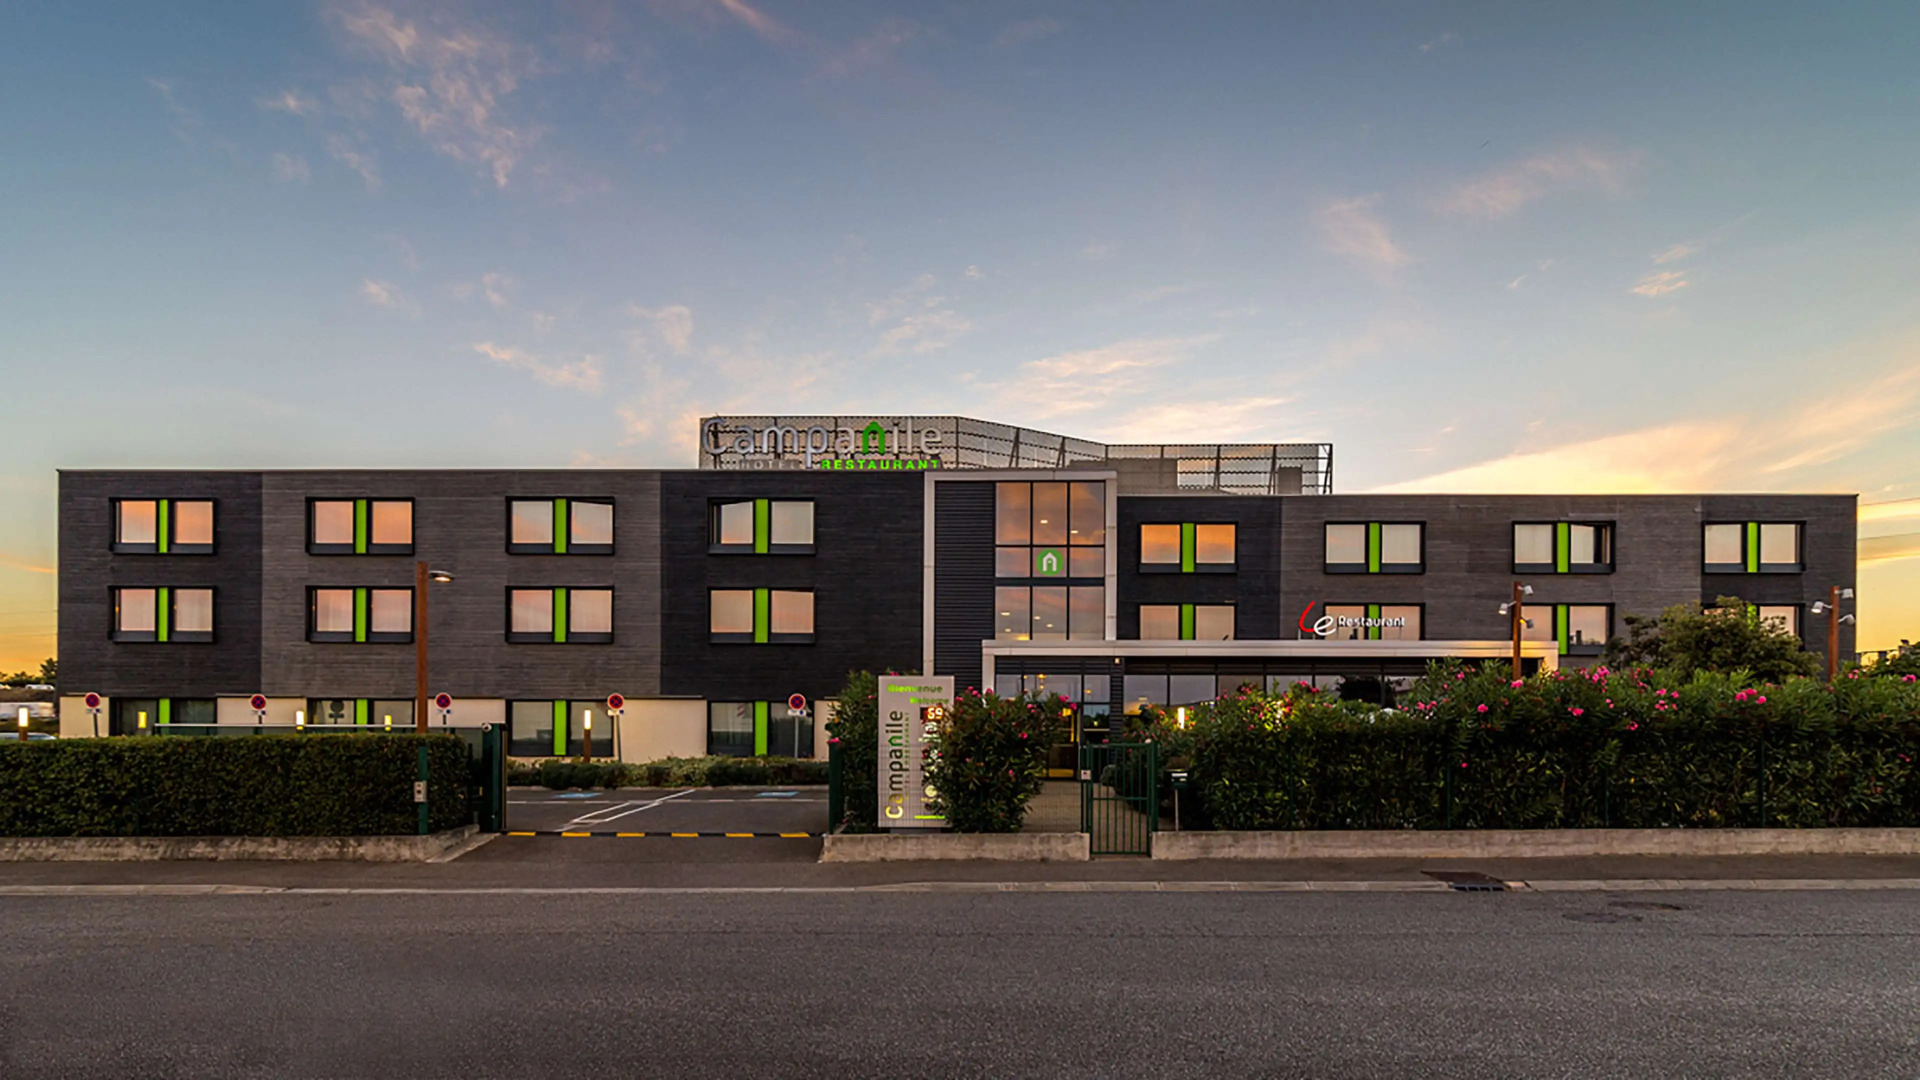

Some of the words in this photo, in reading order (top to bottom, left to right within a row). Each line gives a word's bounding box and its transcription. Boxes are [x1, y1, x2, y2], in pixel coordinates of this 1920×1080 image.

[700, 416, 943, 468] Campanile
[821, 459, 940, 470] RESTAURANT
[1299, 600, 1336, 635] Le
[1338, 615, 1406, 627] Restaurant
[886, 710, 910, 819] Campanile
